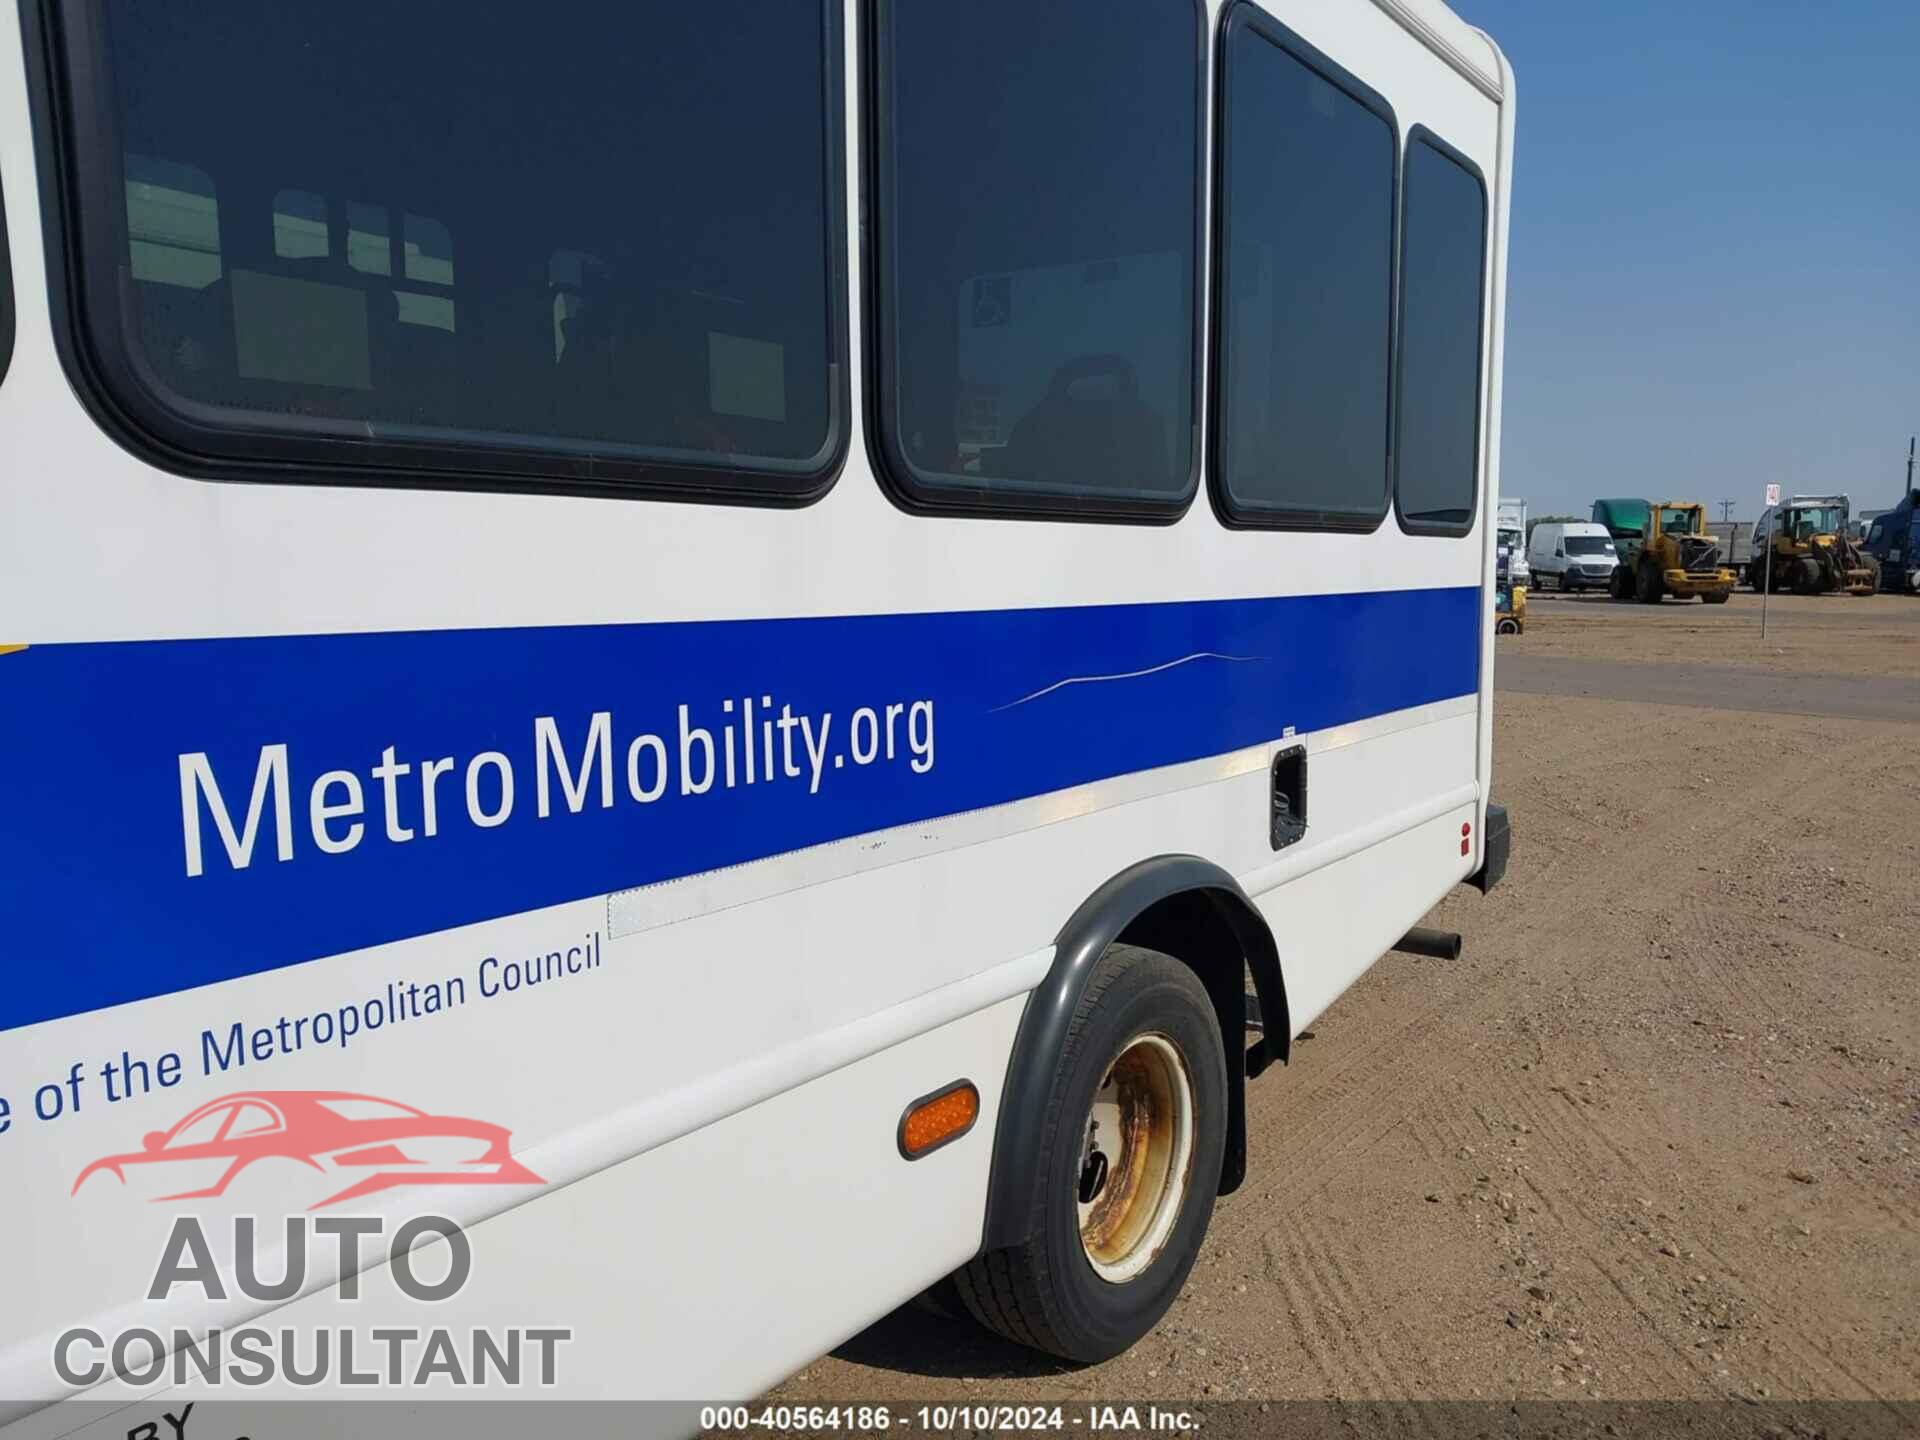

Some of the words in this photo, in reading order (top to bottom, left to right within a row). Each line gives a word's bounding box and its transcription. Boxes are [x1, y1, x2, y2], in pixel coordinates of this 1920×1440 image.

[178, 695, 936, 878] MetroMobility.org
[34, 1062, 85, 1121] of
[99, 1051, 182, 1103] the
[200, 976, 466, 1077] Metropolitan
[478, 931, 602, 996] Council
